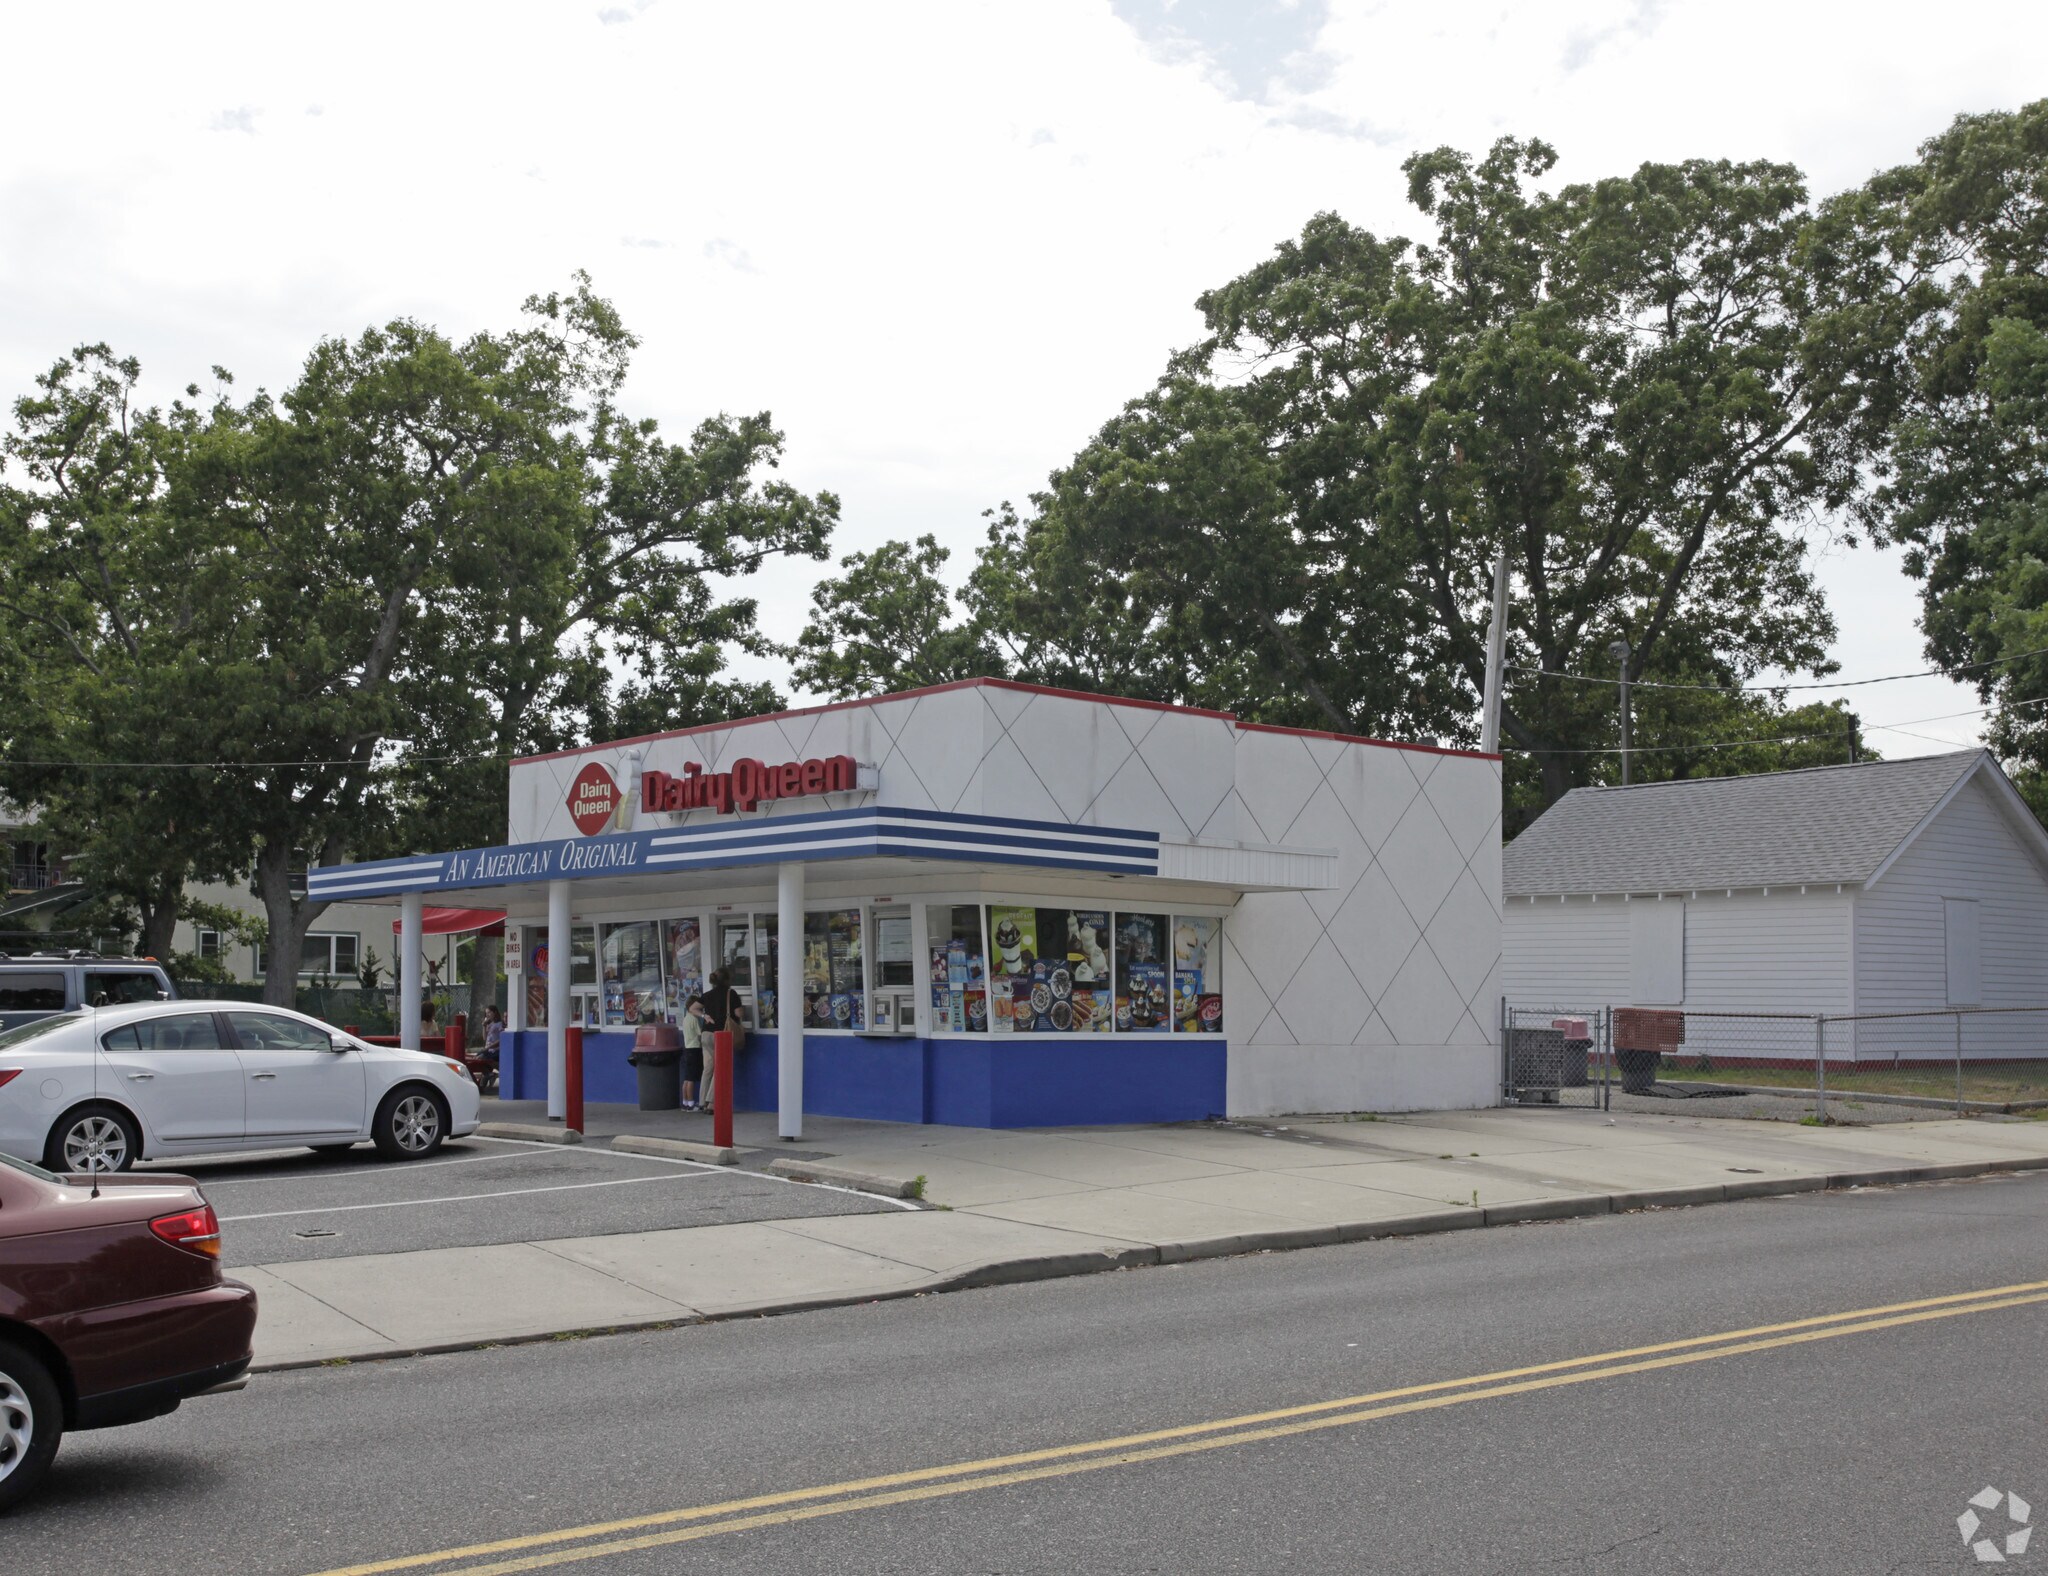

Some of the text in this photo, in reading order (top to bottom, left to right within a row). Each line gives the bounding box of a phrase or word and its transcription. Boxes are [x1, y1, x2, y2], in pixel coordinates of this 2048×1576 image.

[580, 779, 611, 798] Dairy
[642, 755, 857, 815] Dairy Queen
[574, 800, 611, 819] Queen
[472, 850, 552, 880] AMERICAN
[560, 840, 638, 871] ORIGINAL
[510, 932, 517, 942] NO
[506, 943, 520, 953] BIKES
[506, 960, 520, 969] IN AREA
